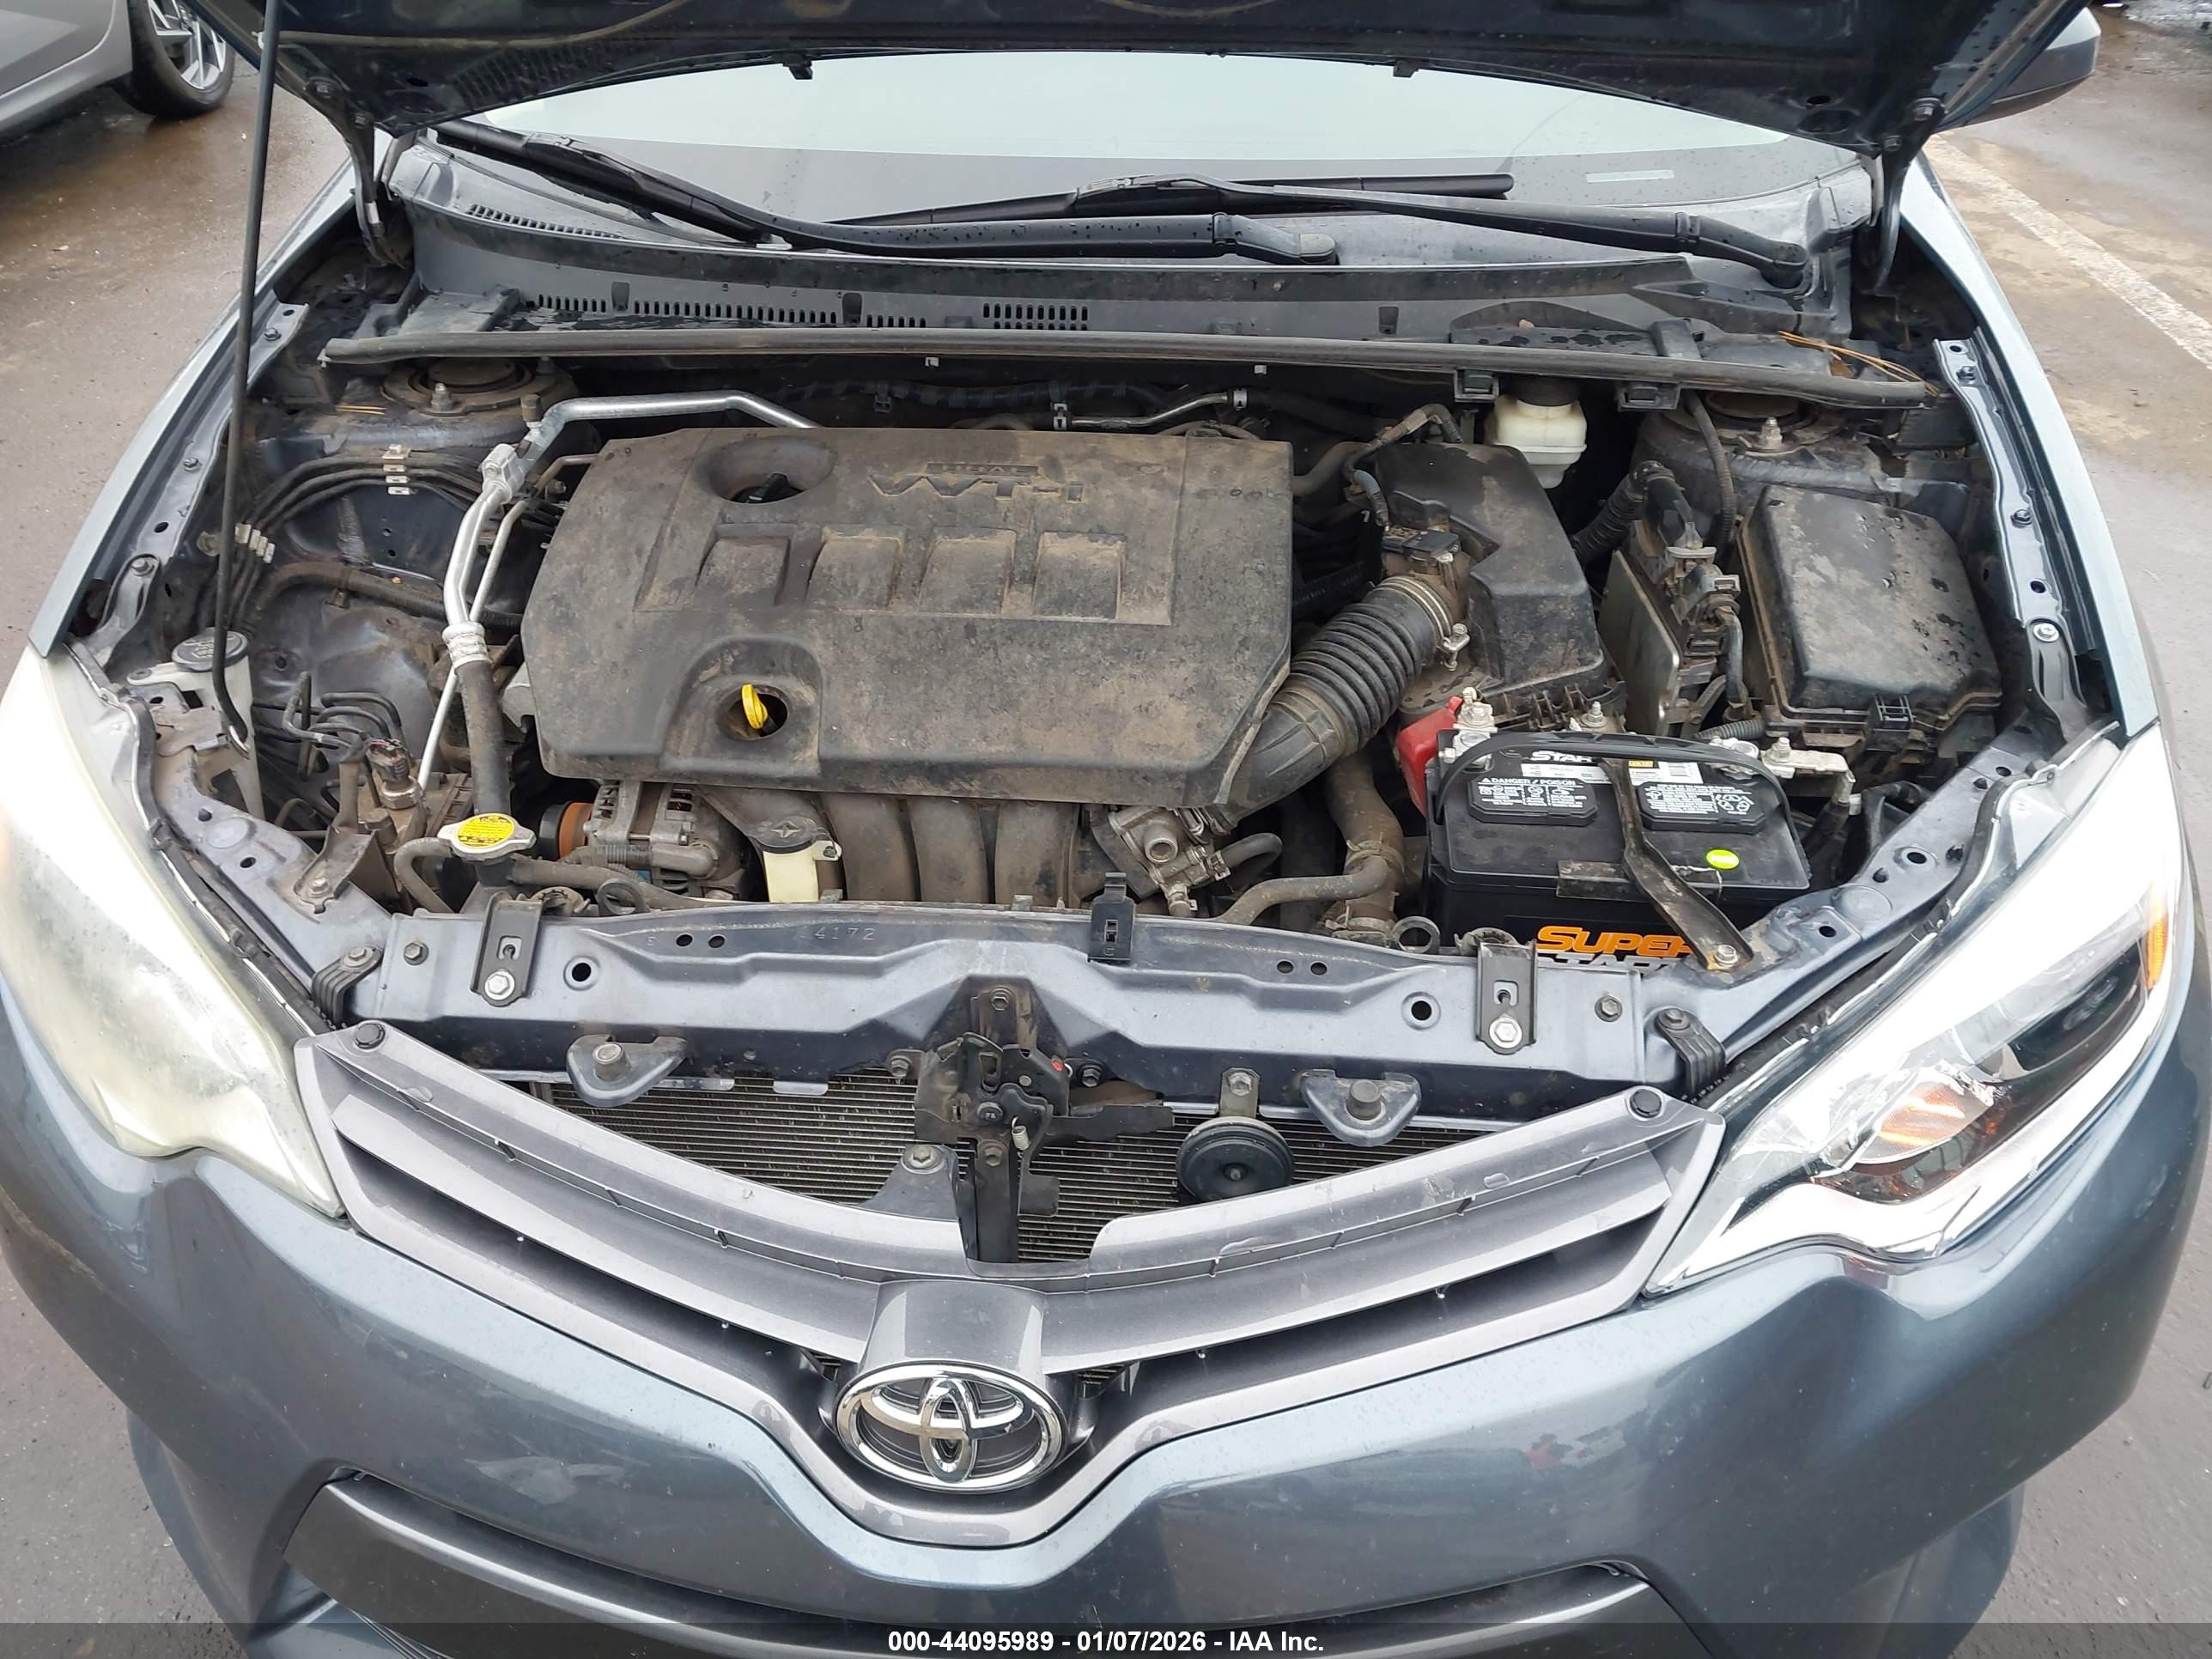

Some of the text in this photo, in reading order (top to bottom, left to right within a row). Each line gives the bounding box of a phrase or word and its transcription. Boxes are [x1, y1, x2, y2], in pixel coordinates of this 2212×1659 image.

[1530, 750, 1594, 763] STAR
[813, 926, 877, 942] 4172
[1538, 951, 1681, 977] TAR
